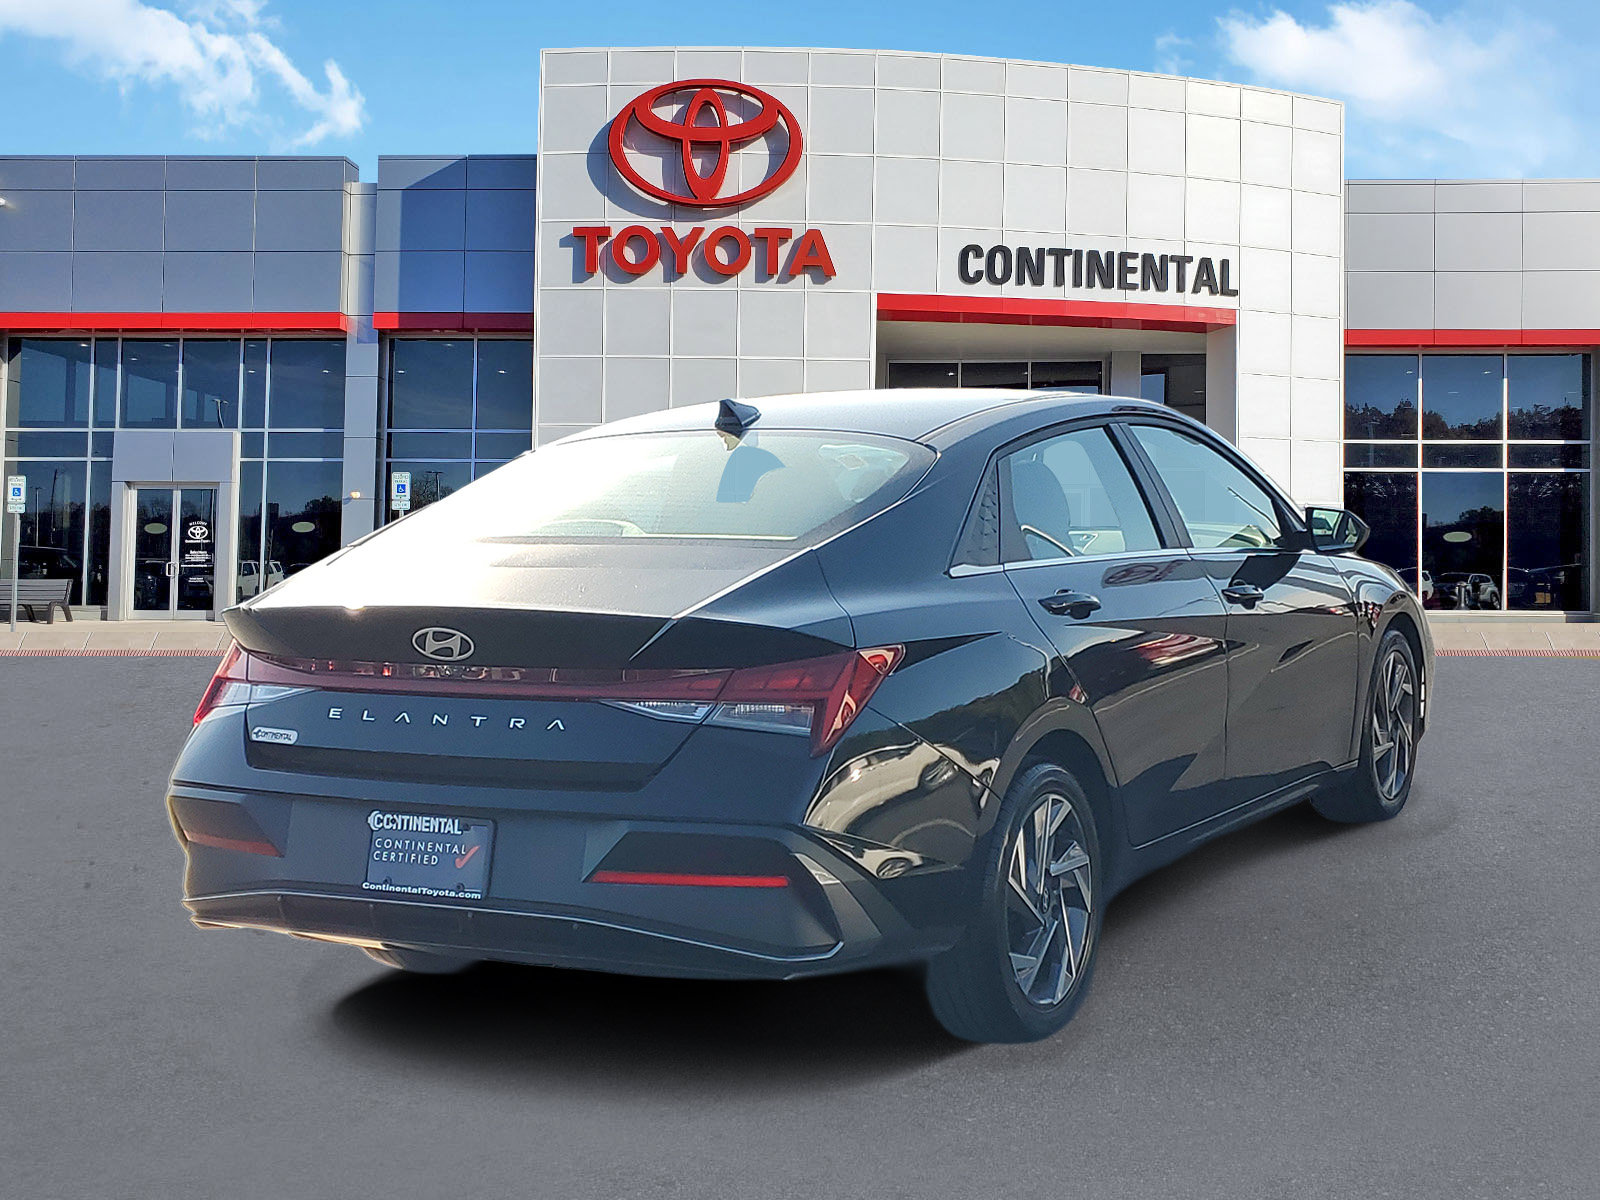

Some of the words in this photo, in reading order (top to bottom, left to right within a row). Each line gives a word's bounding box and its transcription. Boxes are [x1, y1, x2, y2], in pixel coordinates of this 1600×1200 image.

[572, 225, 836, 276] TOYOTA
[958, 244, 1239, 297] CONTINENTAL
[328, 707, 565, 730] ELANTRA
[368, 810, 463, 835] CONTINENTAL
[373, 850, 439, 866] CERTIFIED
[374, 838, 467, 855] CONTINENTAL
[362, 881, 482, 900] ContinentalToyota.com
